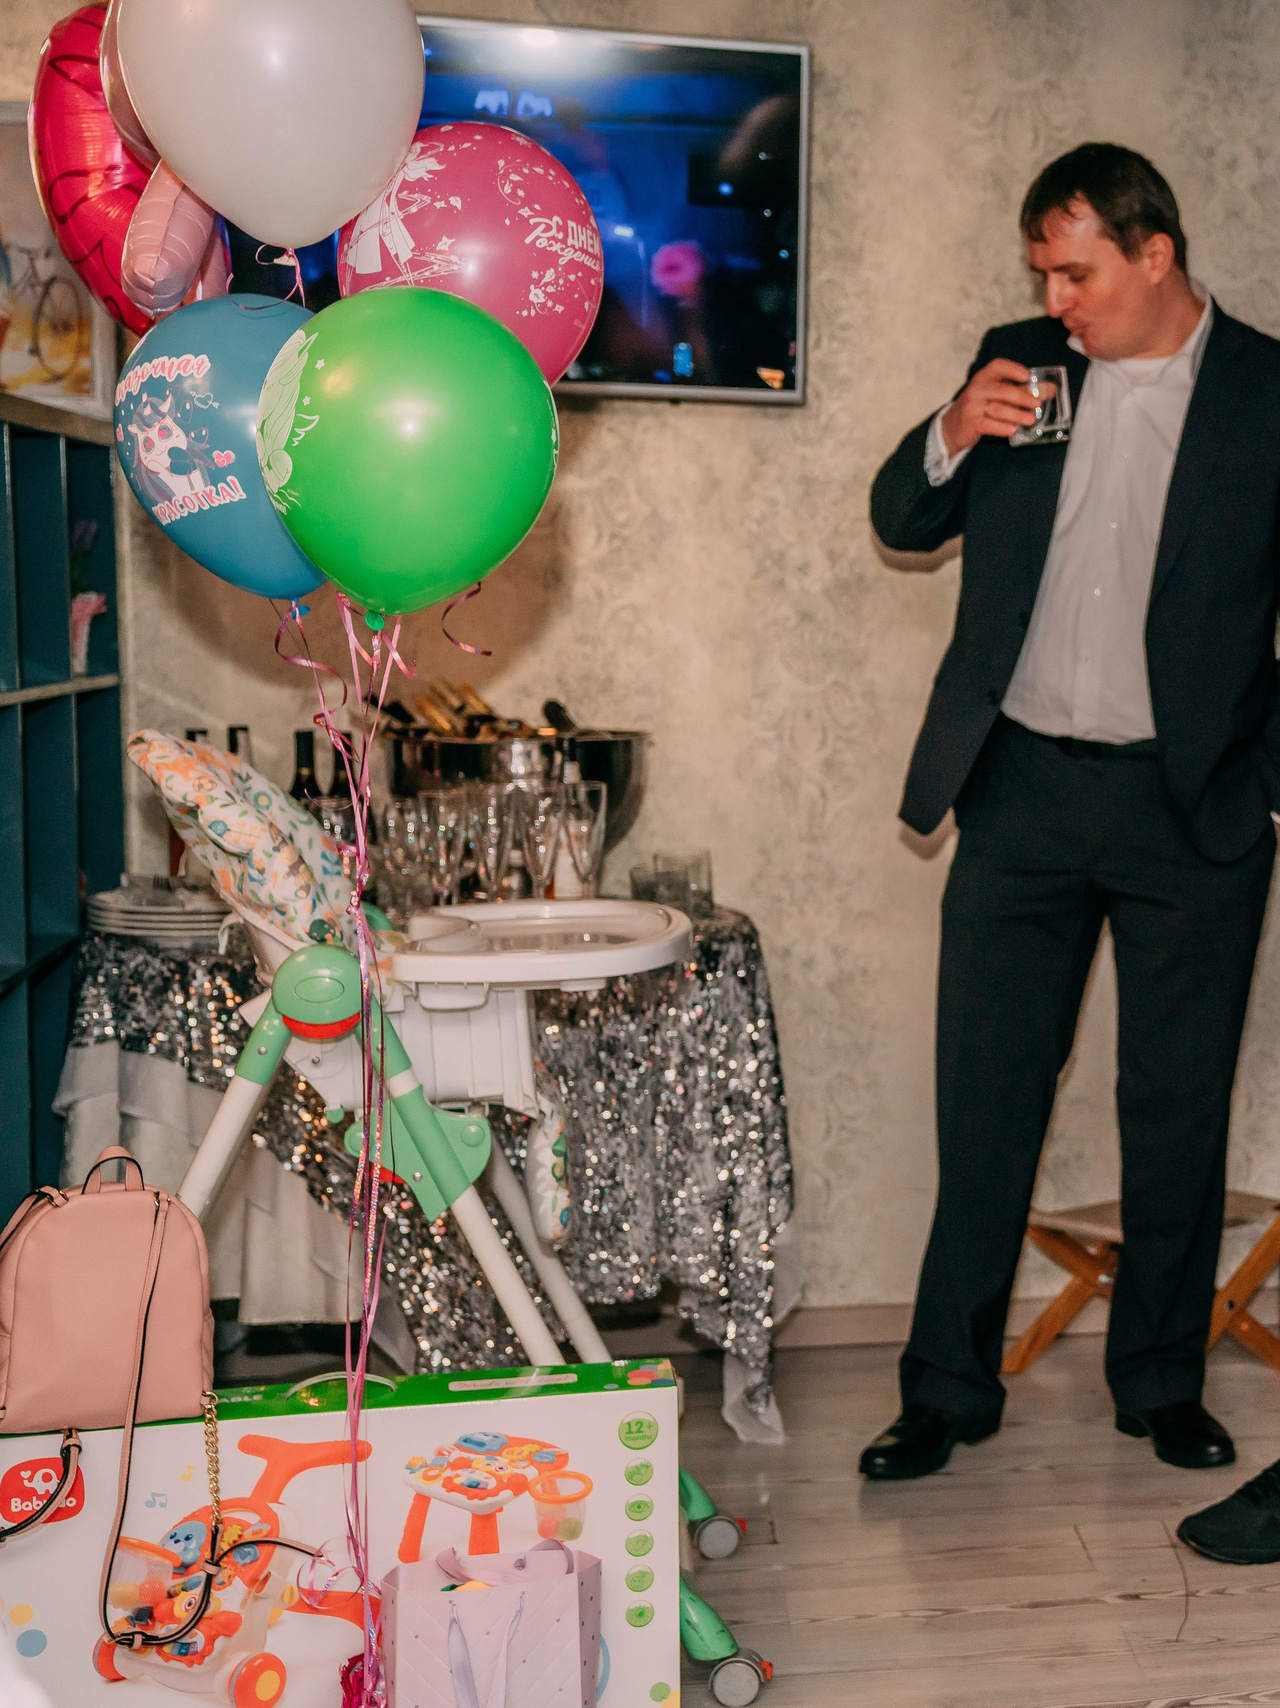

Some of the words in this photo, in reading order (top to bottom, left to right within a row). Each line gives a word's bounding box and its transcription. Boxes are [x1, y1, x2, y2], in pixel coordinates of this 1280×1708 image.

[524, 217, 600, 272] Рождения
[567, 220, 601, 258] ДНЁМ
[114, 354, 211, 407] казочная
[152, 475, 246, 526] КРАСОТКА!
[625, 1420, 654, 1435] 12+
[10, 1496, 77, 1513] Babo
